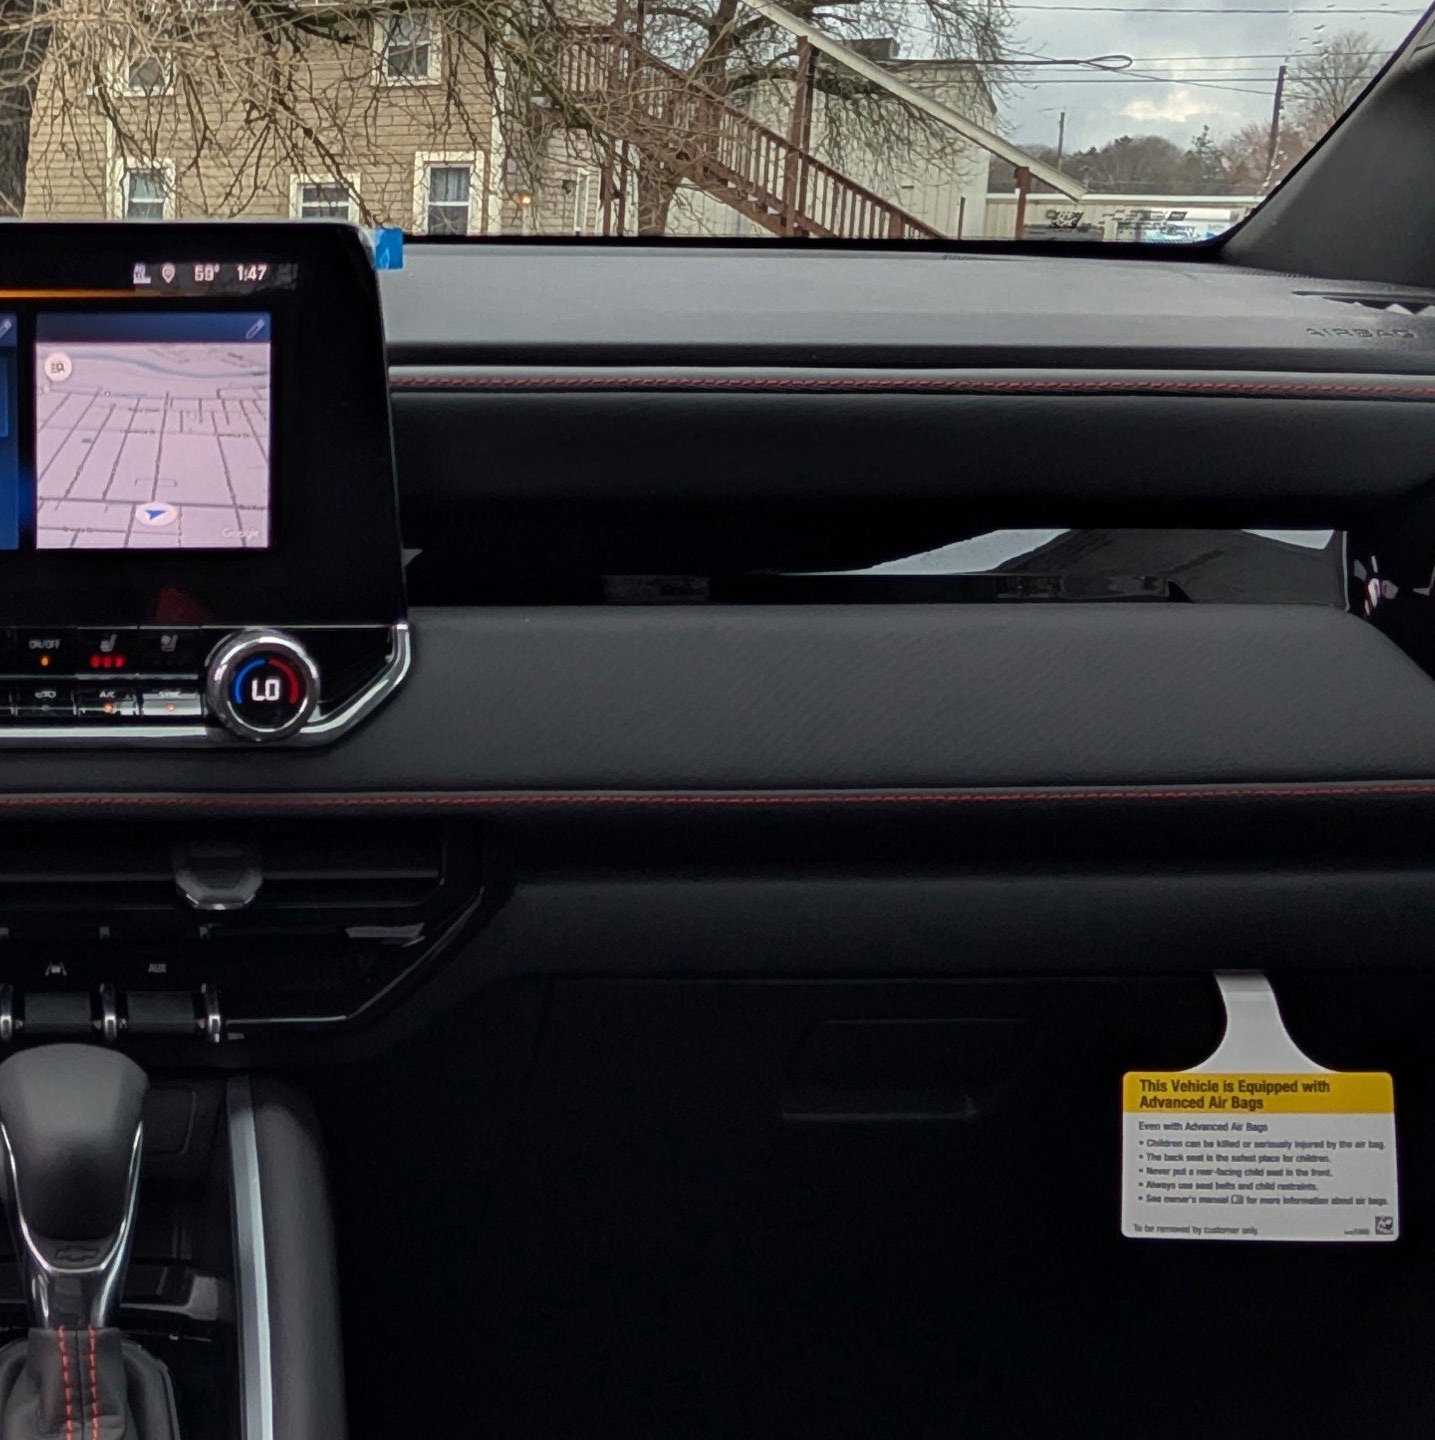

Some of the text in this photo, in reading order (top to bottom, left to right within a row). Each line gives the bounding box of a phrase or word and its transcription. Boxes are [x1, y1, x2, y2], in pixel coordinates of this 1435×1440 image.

[237, 264, 267, 281] 1:47
[252, 678, 280, 701] LO
[147, 962, 168, 974] AUX
[1140, 1079, 1330, 1095] This Vehicle is Equipped with
[1139, 1096, 1264, 1111] Advanced Air Bags
[1139, 1121, 1268, 1133] Even with Advanced Air Bags
